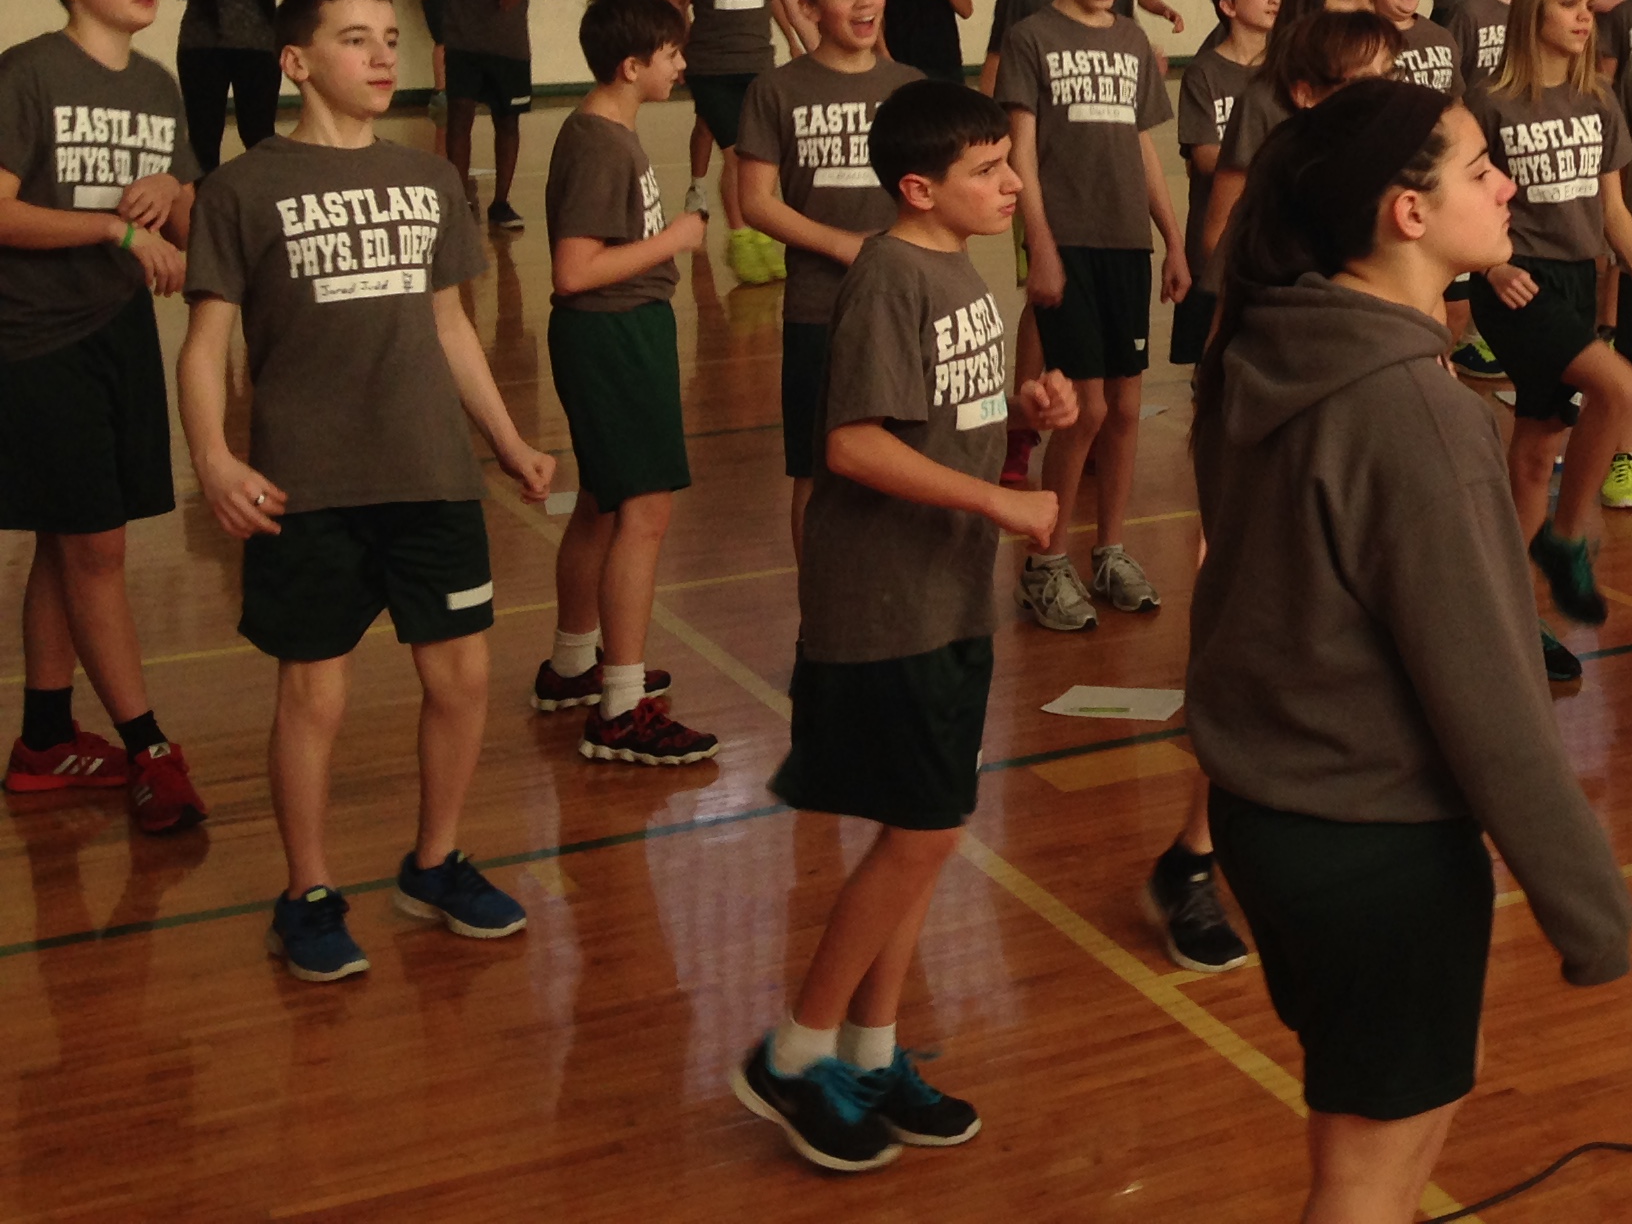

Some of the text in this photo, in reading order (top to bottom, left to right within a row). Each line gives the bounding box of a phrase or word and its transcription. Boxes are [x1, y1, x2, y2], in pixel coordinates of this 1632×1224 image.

[1050, 75, 1097, 107] PHYS.
[1098, 76, 1118, 103] ED.
[53, 104, 177, 153] EASTLAKE
[792, 102, 880, 138] EASTL
[55, 146, 114, 184] PHYS.
[796, 135, 845, 168] PHYS.
[1507, 152, 1556, 186] PHYS.
[275, 185, 441, 237] EASTLAKE
[285, 231, 359, 279] PHYS.
[359, 227, 397, 268] ED.
[933, 292, 1004, 363] EASTLA
[933, 350, 993, 407] PHYS.
